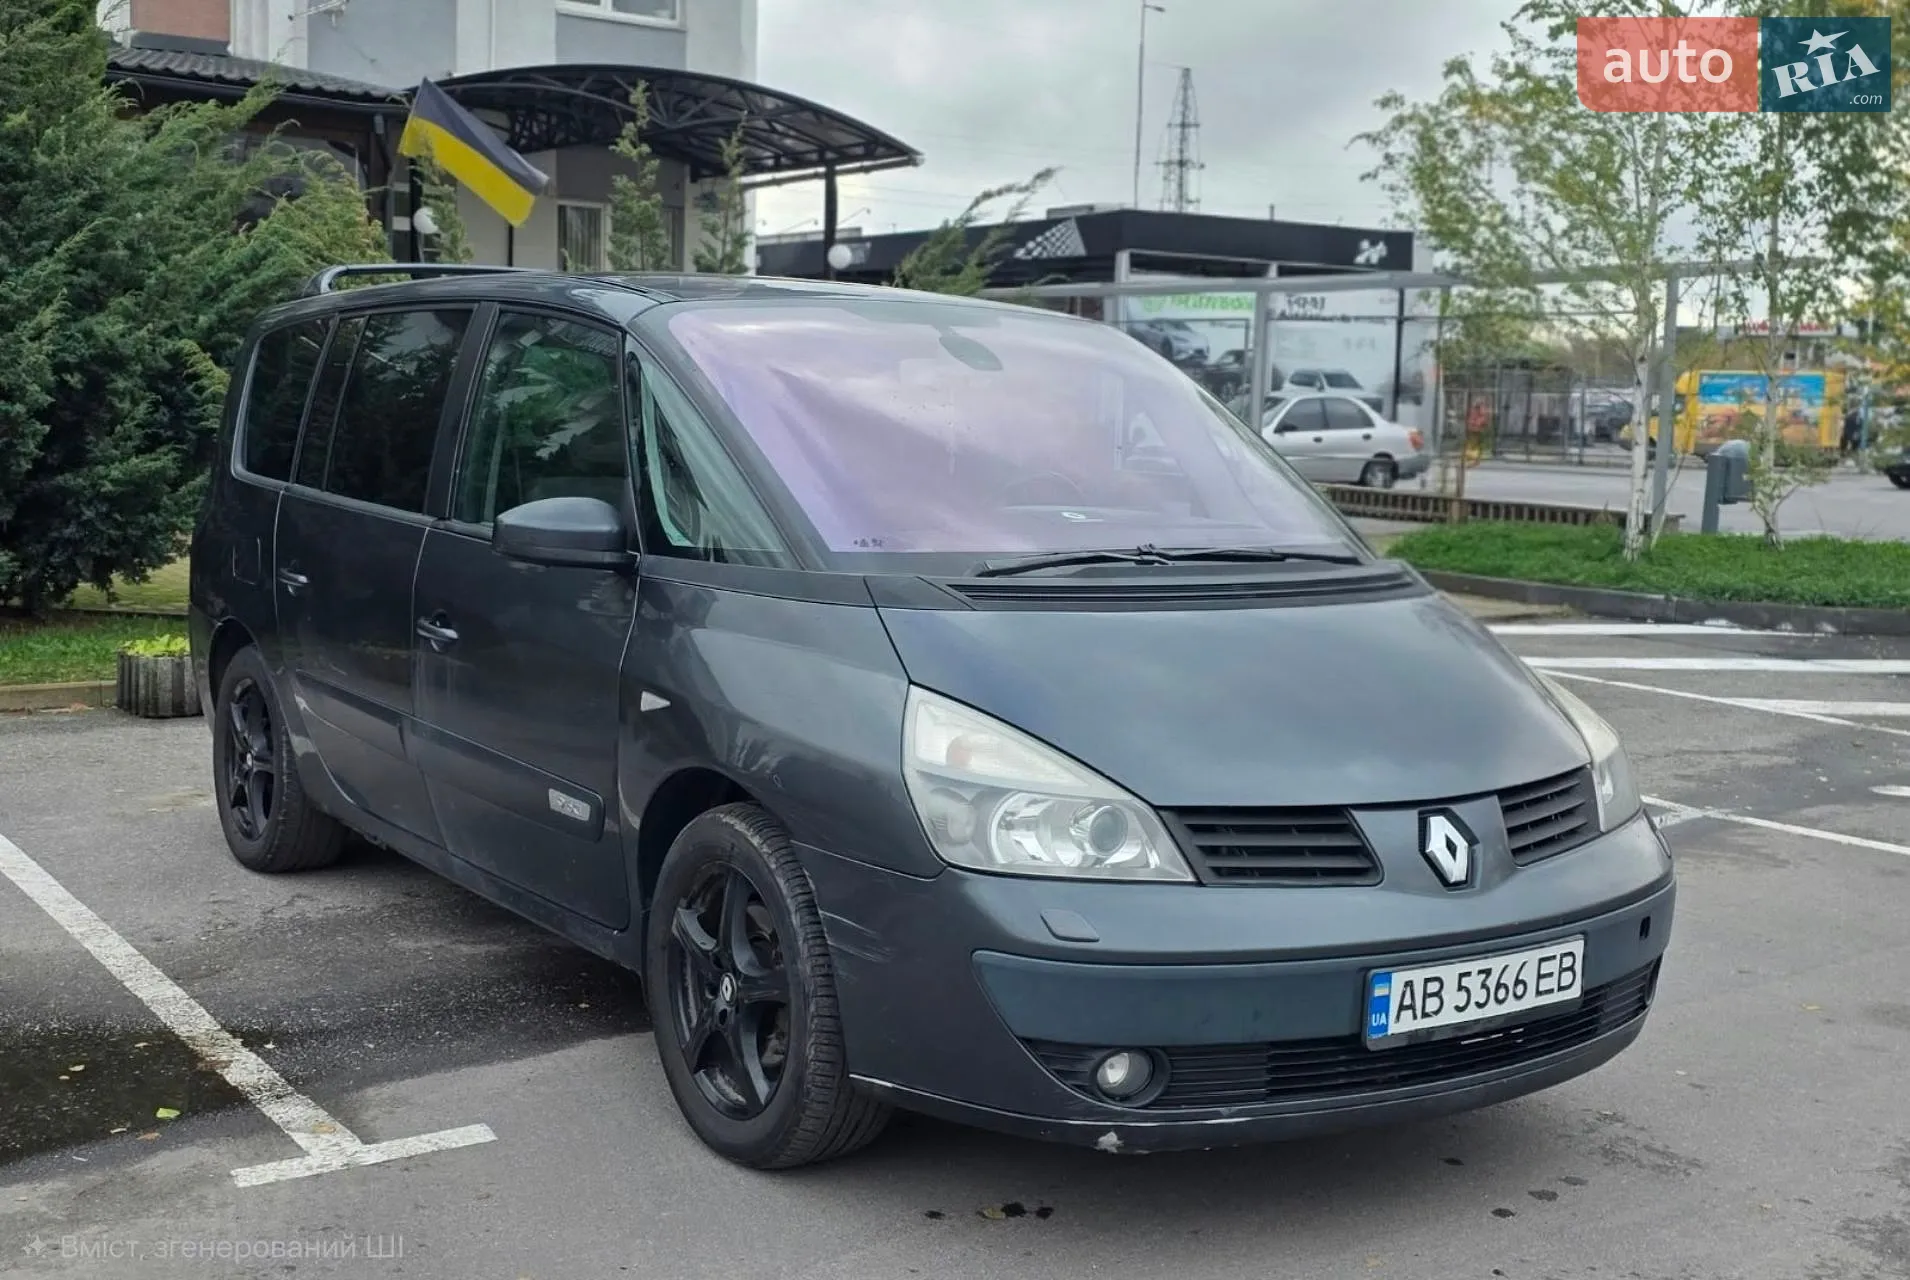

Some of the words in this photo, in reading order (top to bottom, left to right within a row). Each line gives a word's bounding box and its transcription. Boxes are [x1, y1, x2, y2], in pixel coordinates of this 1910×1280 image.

[1393, 976, 1444, 1024] AB
[1453, 960, 1529, 1013] 5366
[1534, 951, 1578, 997] EB
[1372, 1012, 1387, 1027] UA
